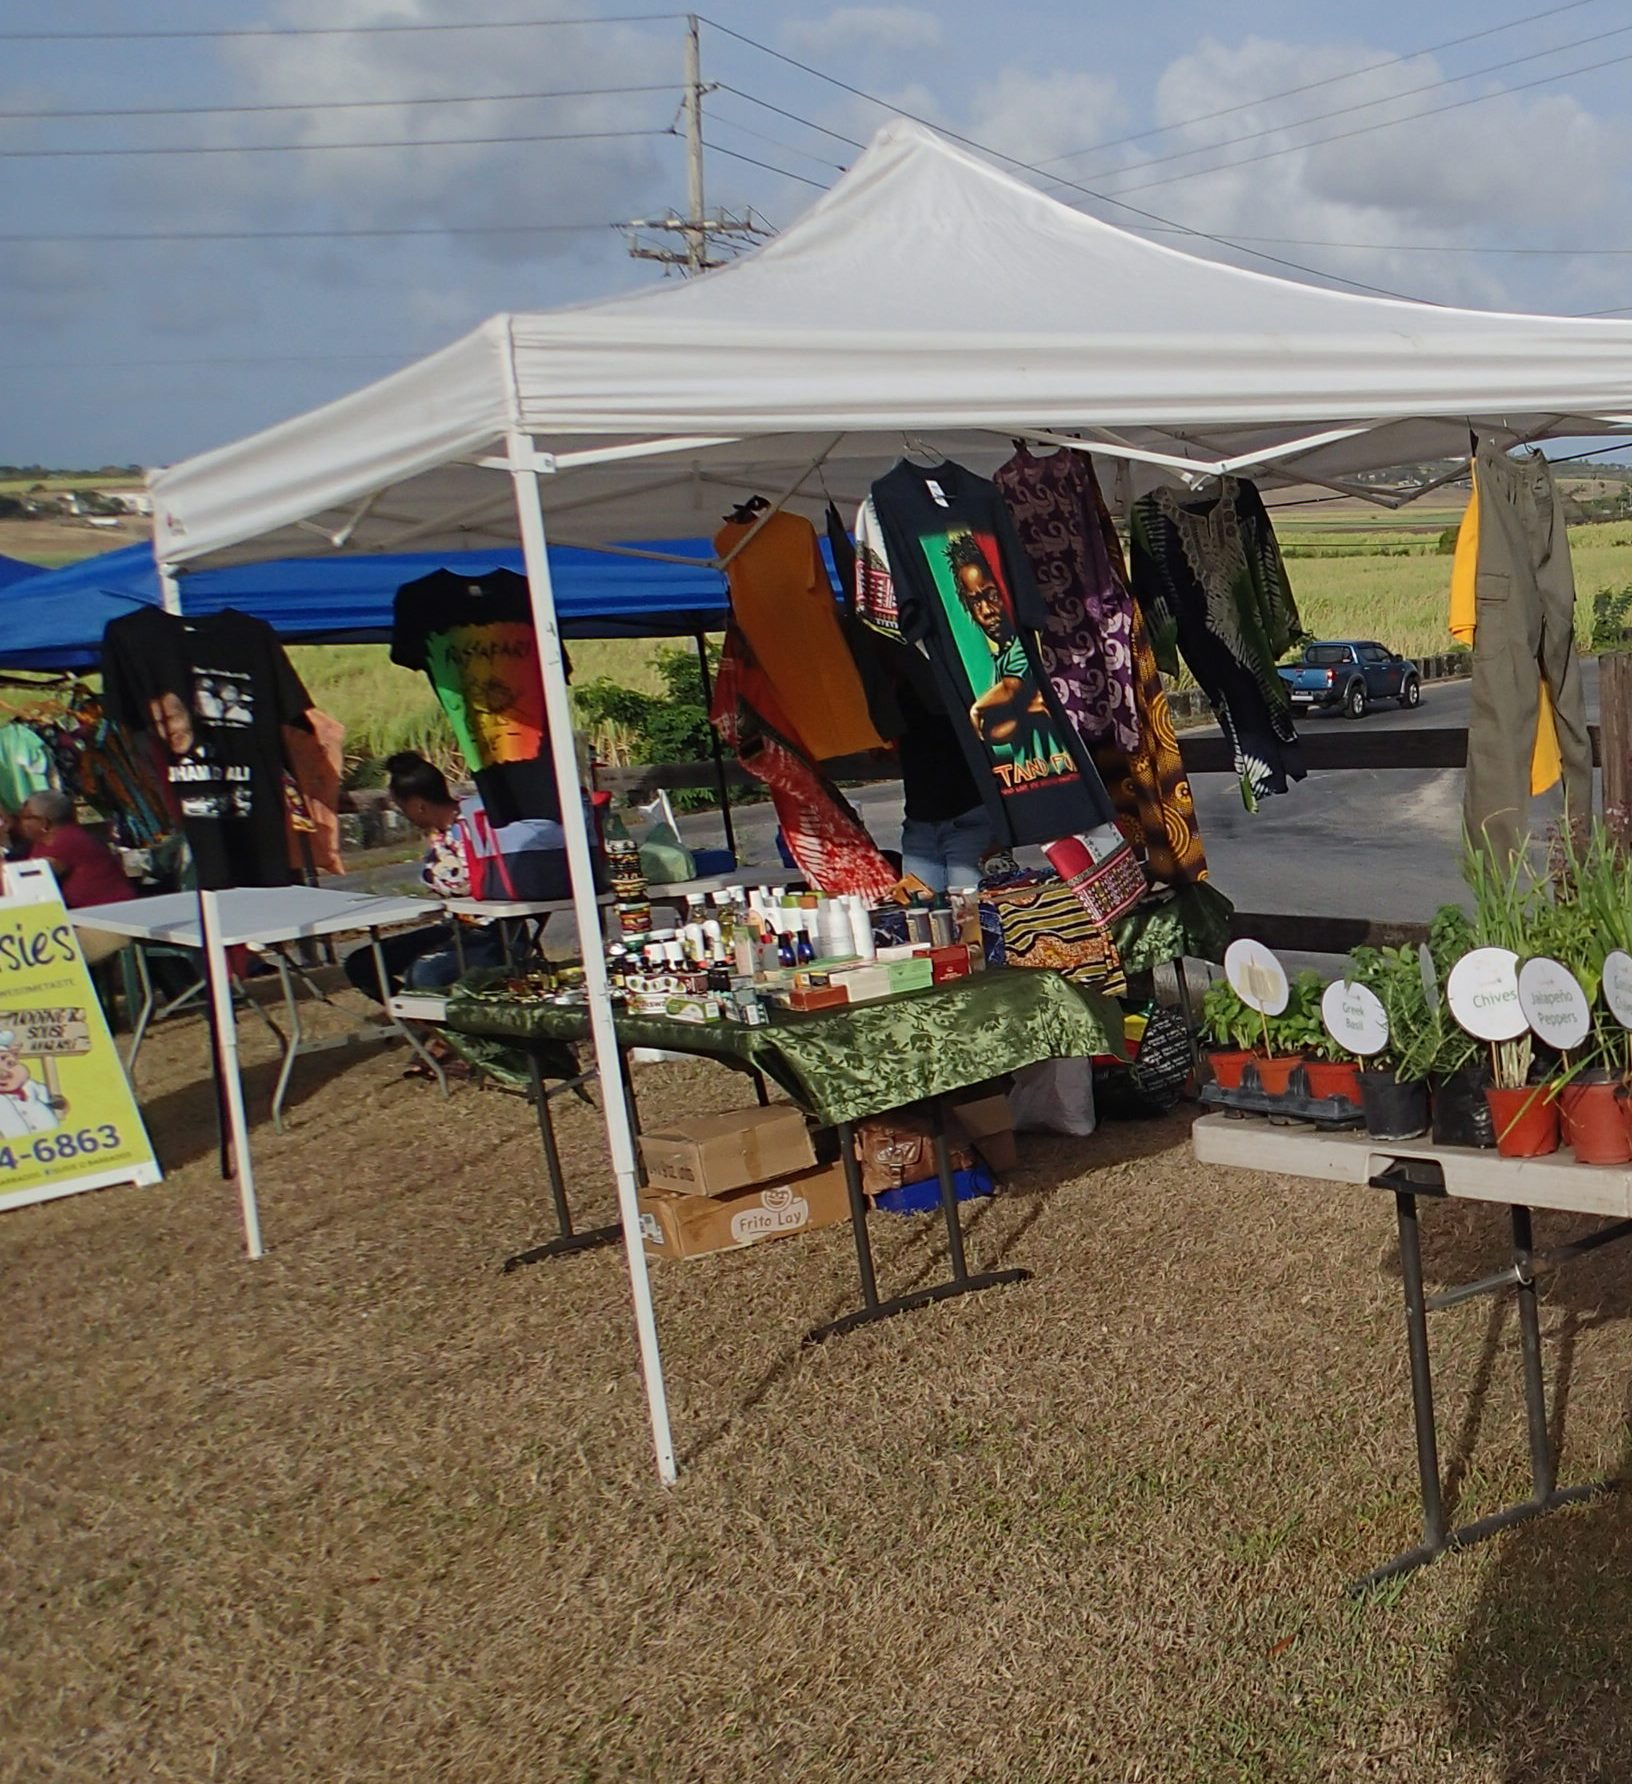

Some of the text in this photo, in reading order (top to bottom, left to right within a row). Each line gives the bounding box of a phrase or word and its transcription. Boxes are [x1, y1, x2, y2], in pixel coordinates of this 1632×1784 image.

[226, 765, 250, 781] ALI
[1473, 990, 1517, 1008] Chives
[1343, 1002, 1364, 1016] Greek
[1345, 1018, 1364, 1031] Basil
[1538, 1012, 1578, 1027] Peppers
[0, 1125, 120, 1169] 4-6863
[740, 1212, 801, 1232] Frito Lay
